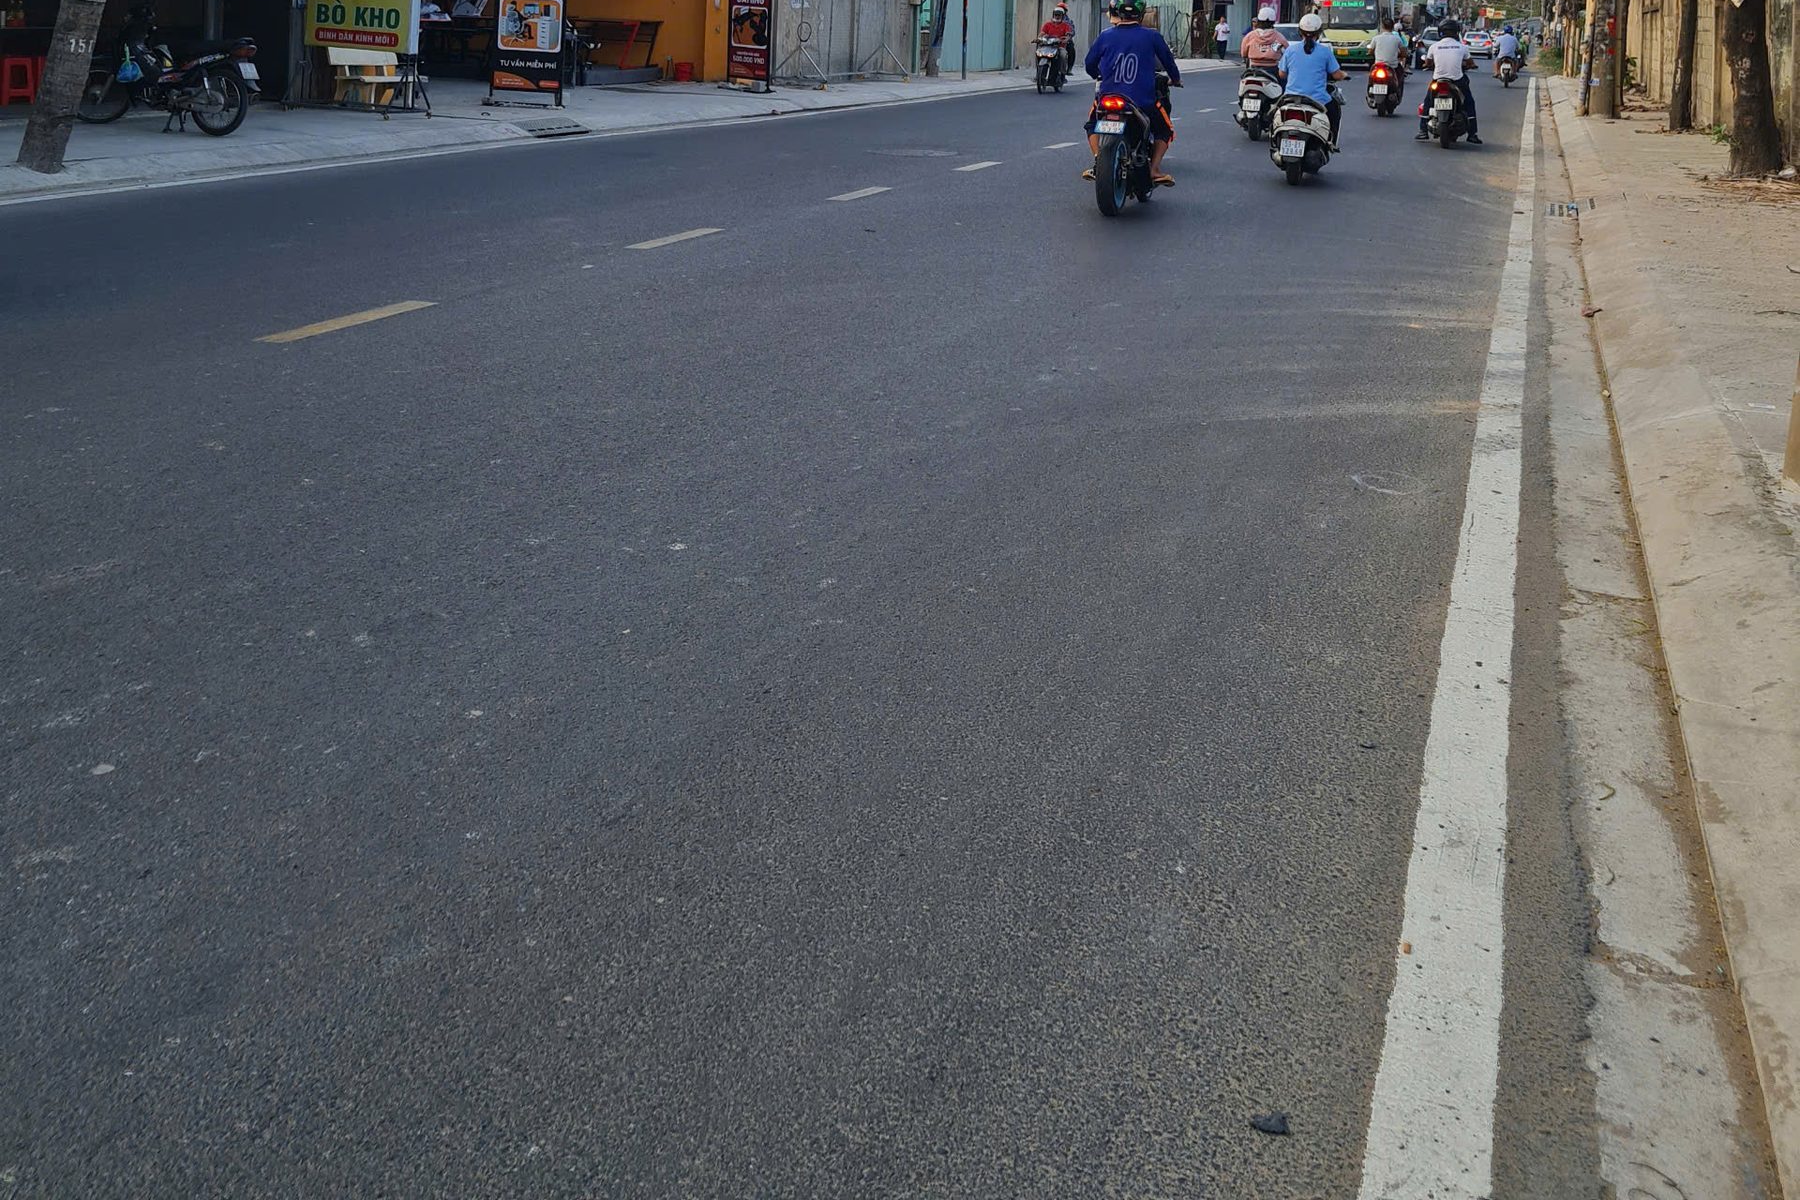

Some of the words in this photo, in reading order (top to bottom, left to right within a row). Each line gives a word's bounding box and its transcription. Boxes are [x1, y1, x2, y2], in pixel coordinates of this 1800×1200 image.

[316, 0, 346, 25] BÒ
[354, 6, 400, 30] KHO
[319, 27, 337, 39] BÌNH
[1112, 52, 1139, 84] 10
